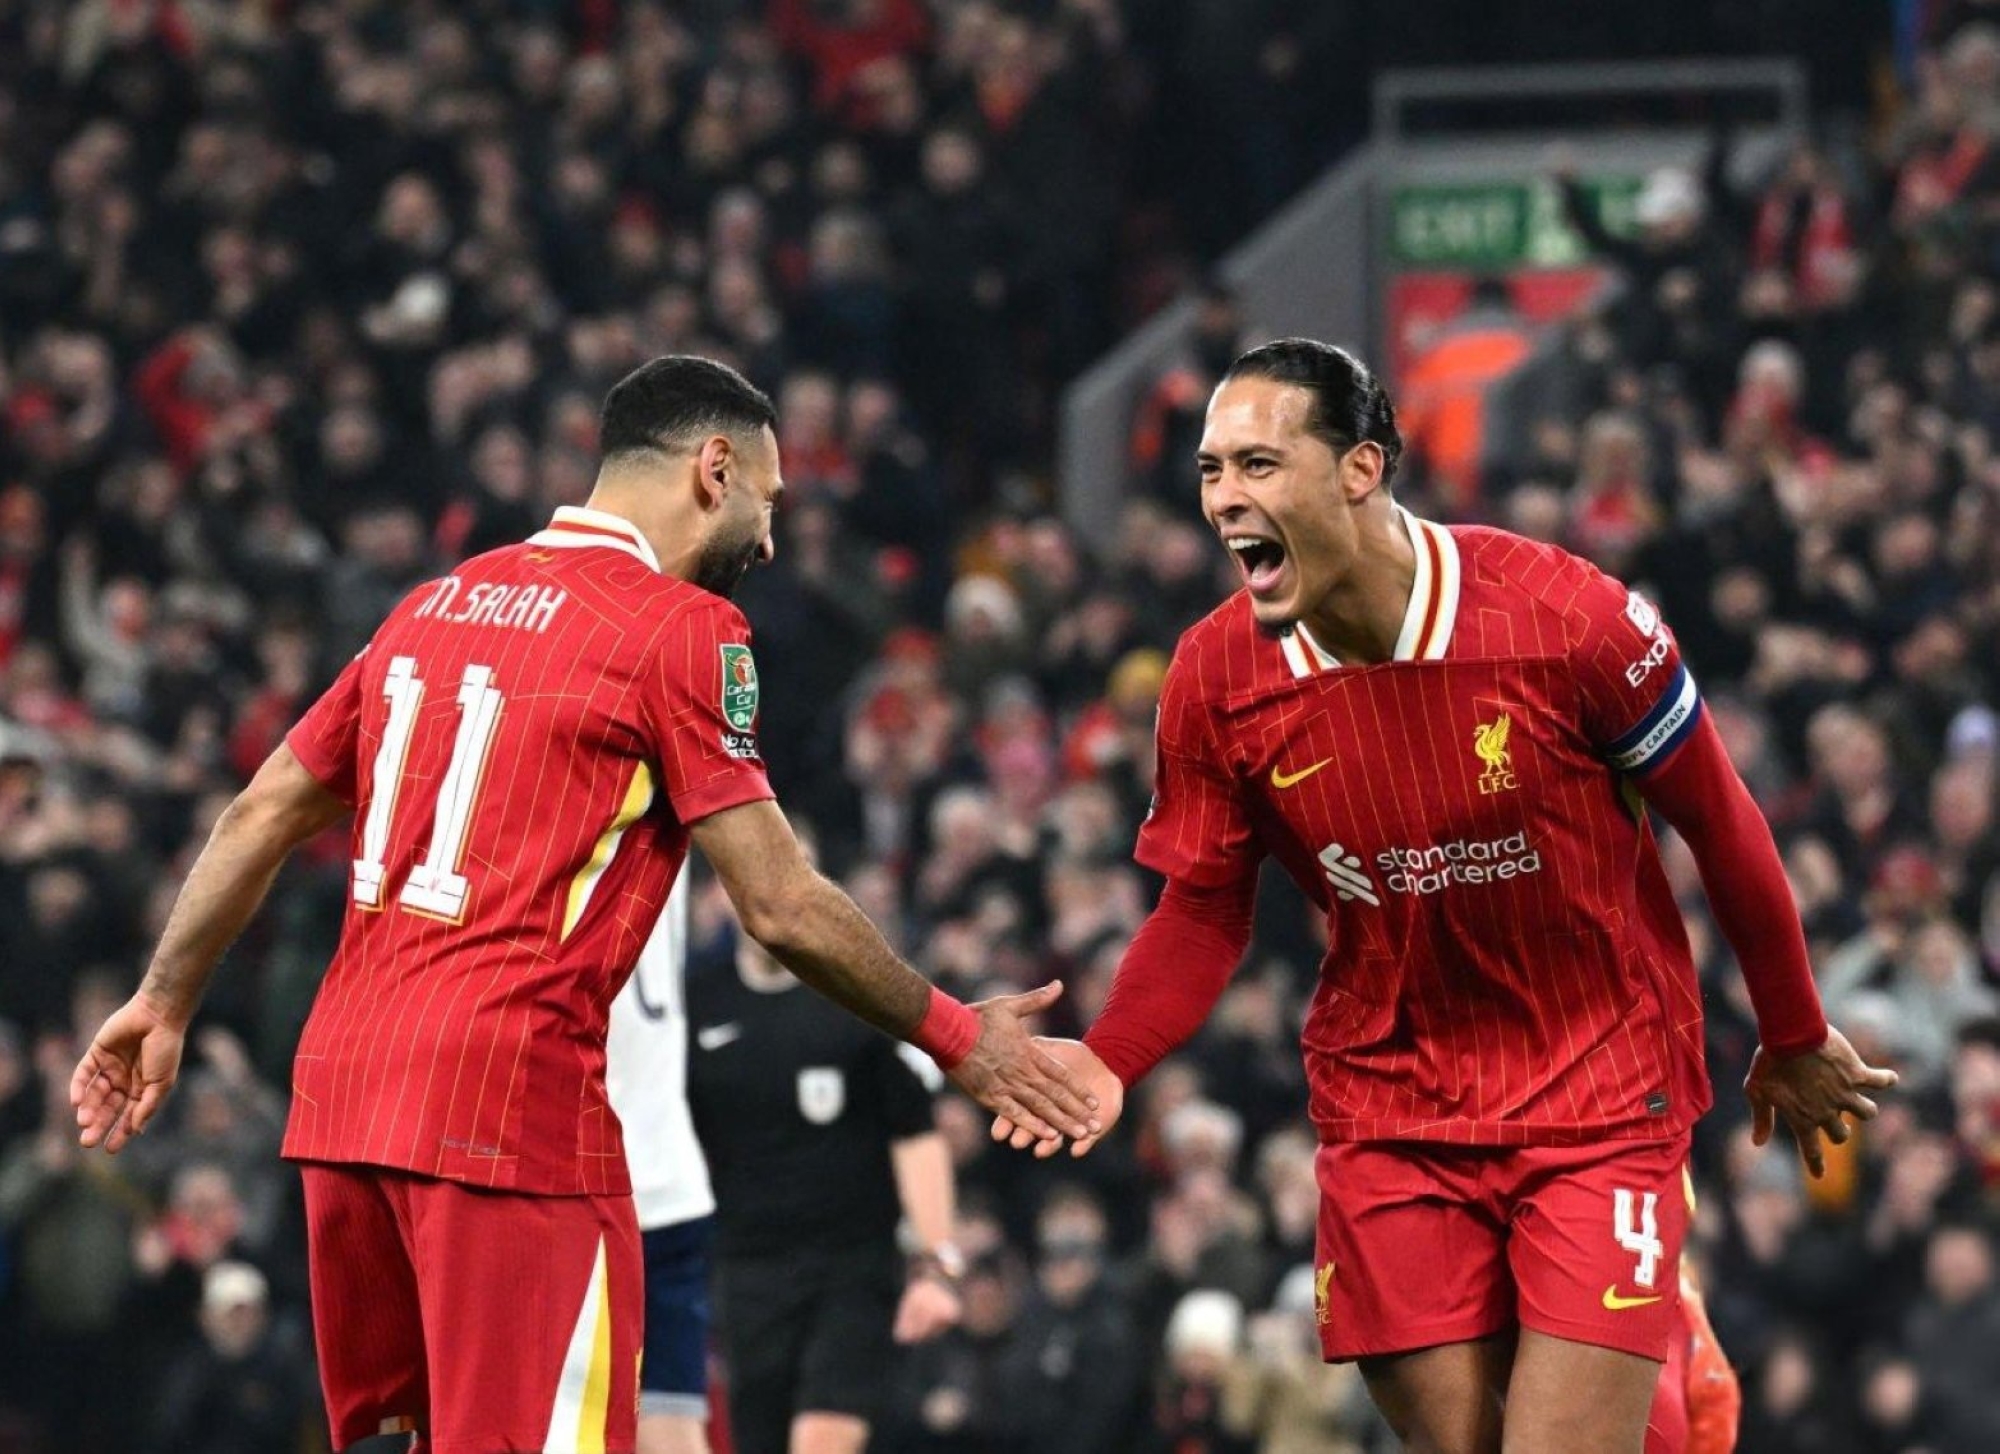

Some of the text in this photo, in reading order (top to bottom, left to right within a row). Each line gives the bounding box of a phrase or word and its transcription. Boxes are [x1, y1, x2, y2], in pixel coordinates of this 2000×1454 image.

[1646, 704, 1687, 749] CAPTAIN
[353, 656, 505, 926] 11
[1376, 830, 1528, 871] standard
[1387, 850, 1542, 896] chartered
[1613, 1187, 1665, 1288] 4
